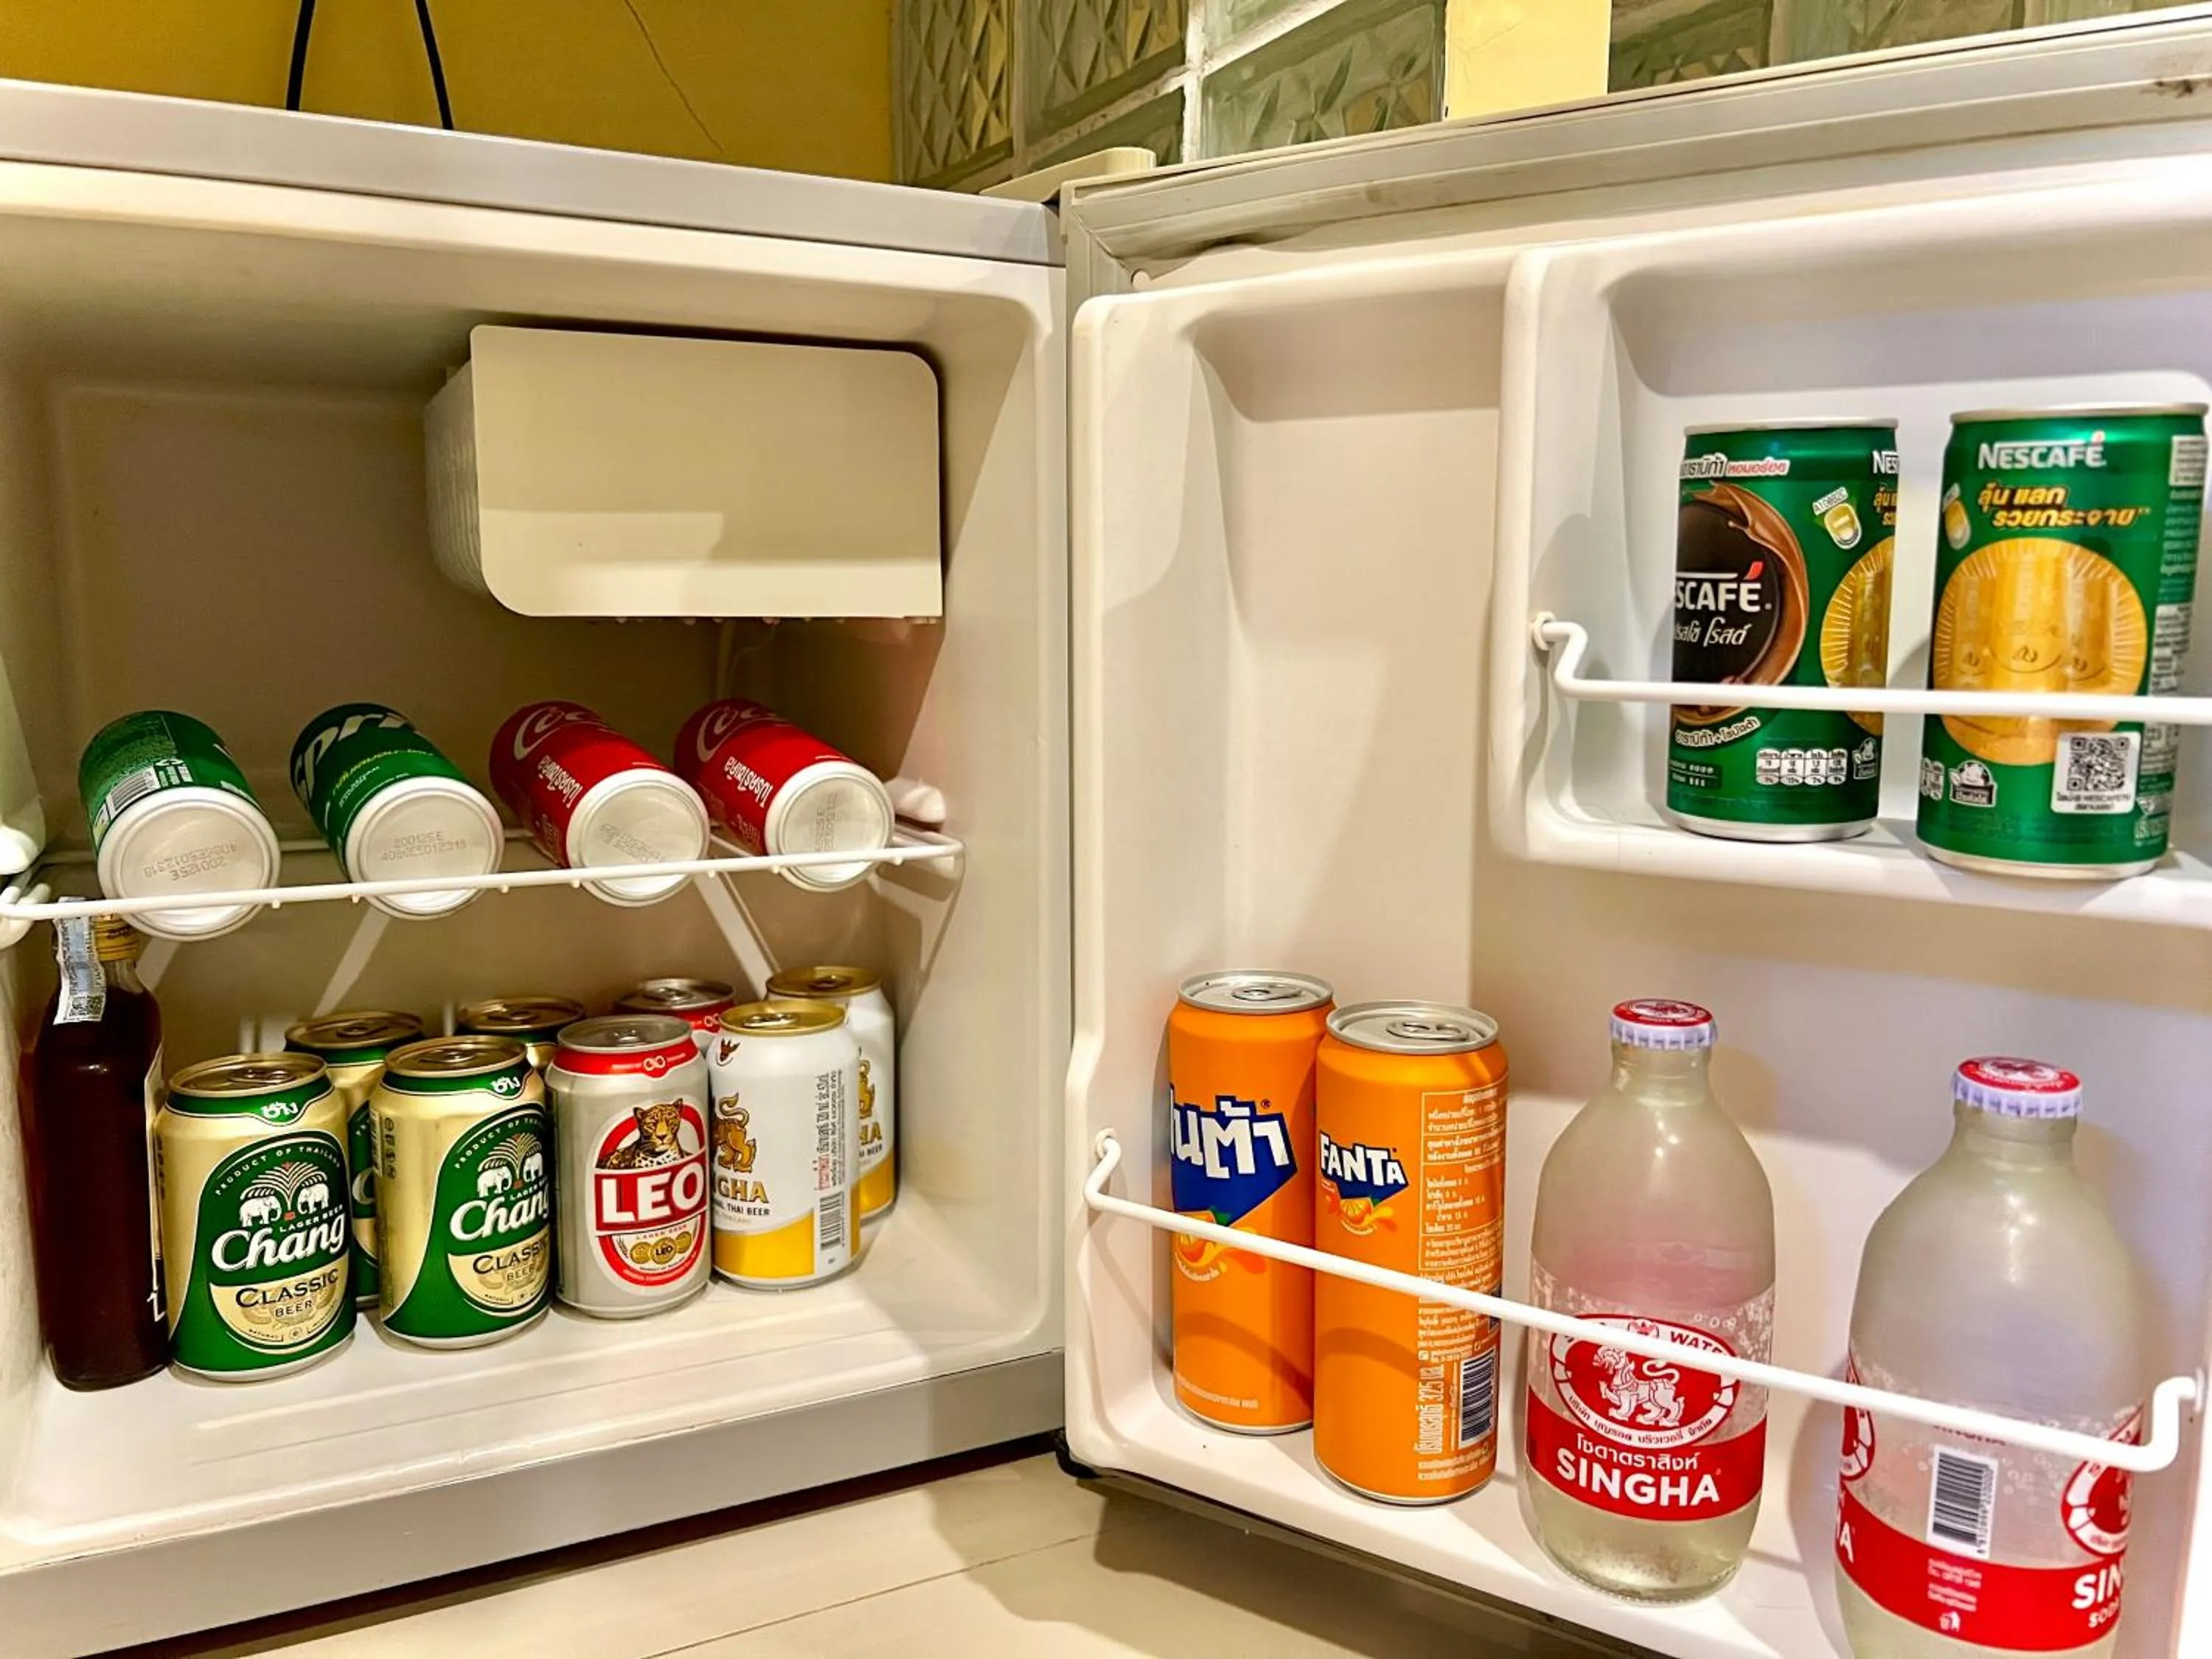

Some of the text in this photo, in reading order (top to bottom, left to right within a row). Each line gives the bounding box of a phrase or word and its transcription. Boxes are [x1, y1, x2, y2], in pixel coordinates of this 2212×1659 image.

[1171, 1089, 1290, 1179] นต้า
[215, 1154, 268, 1196] PRODUCT
[276, 1147, 293, 1157] OF
[1320, 1133, 1406, 1187] FANTA
[601, 1162, 705, 1223] LEO
[715, 1176, 770, 1204] GHA
[279, 1216, 319, 1233] LAGER
[746, 1206, 771, 1217] BEER
[212, 1212, 345, 1272] Chang
[655, 1245, 673, 1256] LEO
[235, 1268, 338, 1307] CLASSIC
[274, 1300, 313, 1318] BEER
[1419, 1380, 1445, 1402] 325
[1576, 1433, 1701, 1470] โซดาตราสิงห์
[1557, 1447, 1720, 1507] SINGHA
